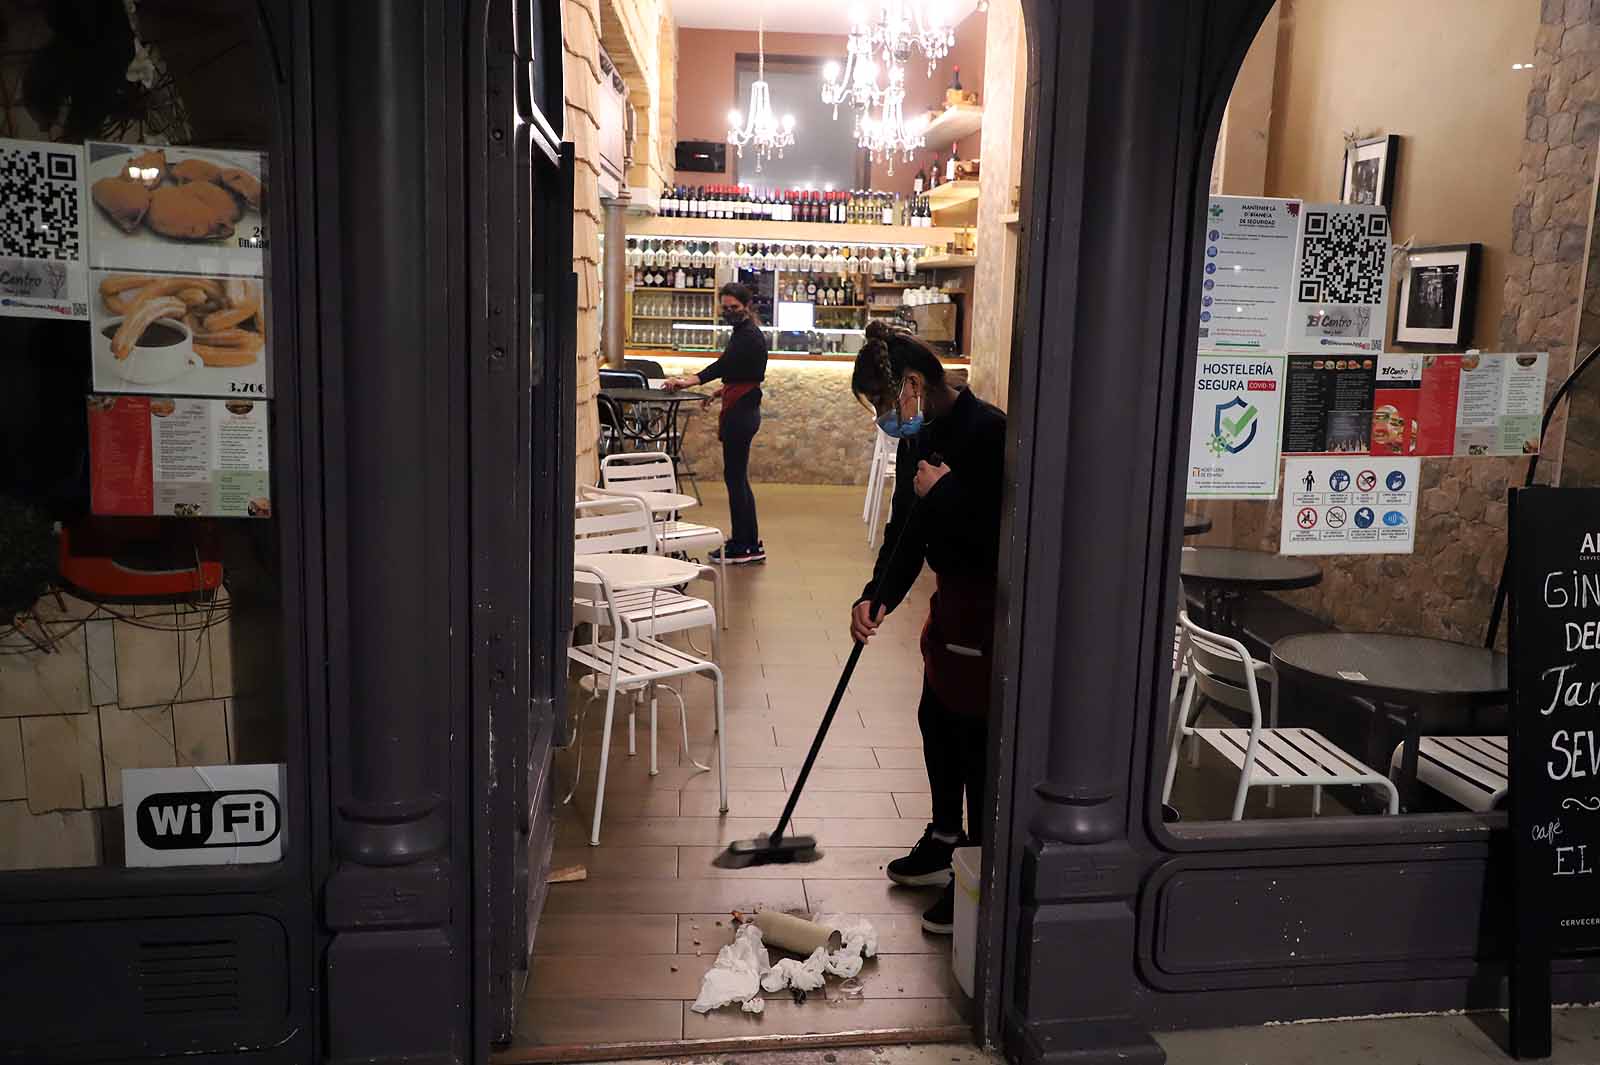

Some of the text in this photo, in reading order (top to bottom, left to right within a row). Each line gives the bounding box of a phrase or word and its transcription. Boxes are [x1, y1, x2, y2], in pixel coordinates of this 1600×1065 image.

[1321, 315, 1352, 328] Centro
[1203, 362, 1273, 375] HOSTELERÍA
[1198, 379, 1274, 391] SEGURA COVID-19
